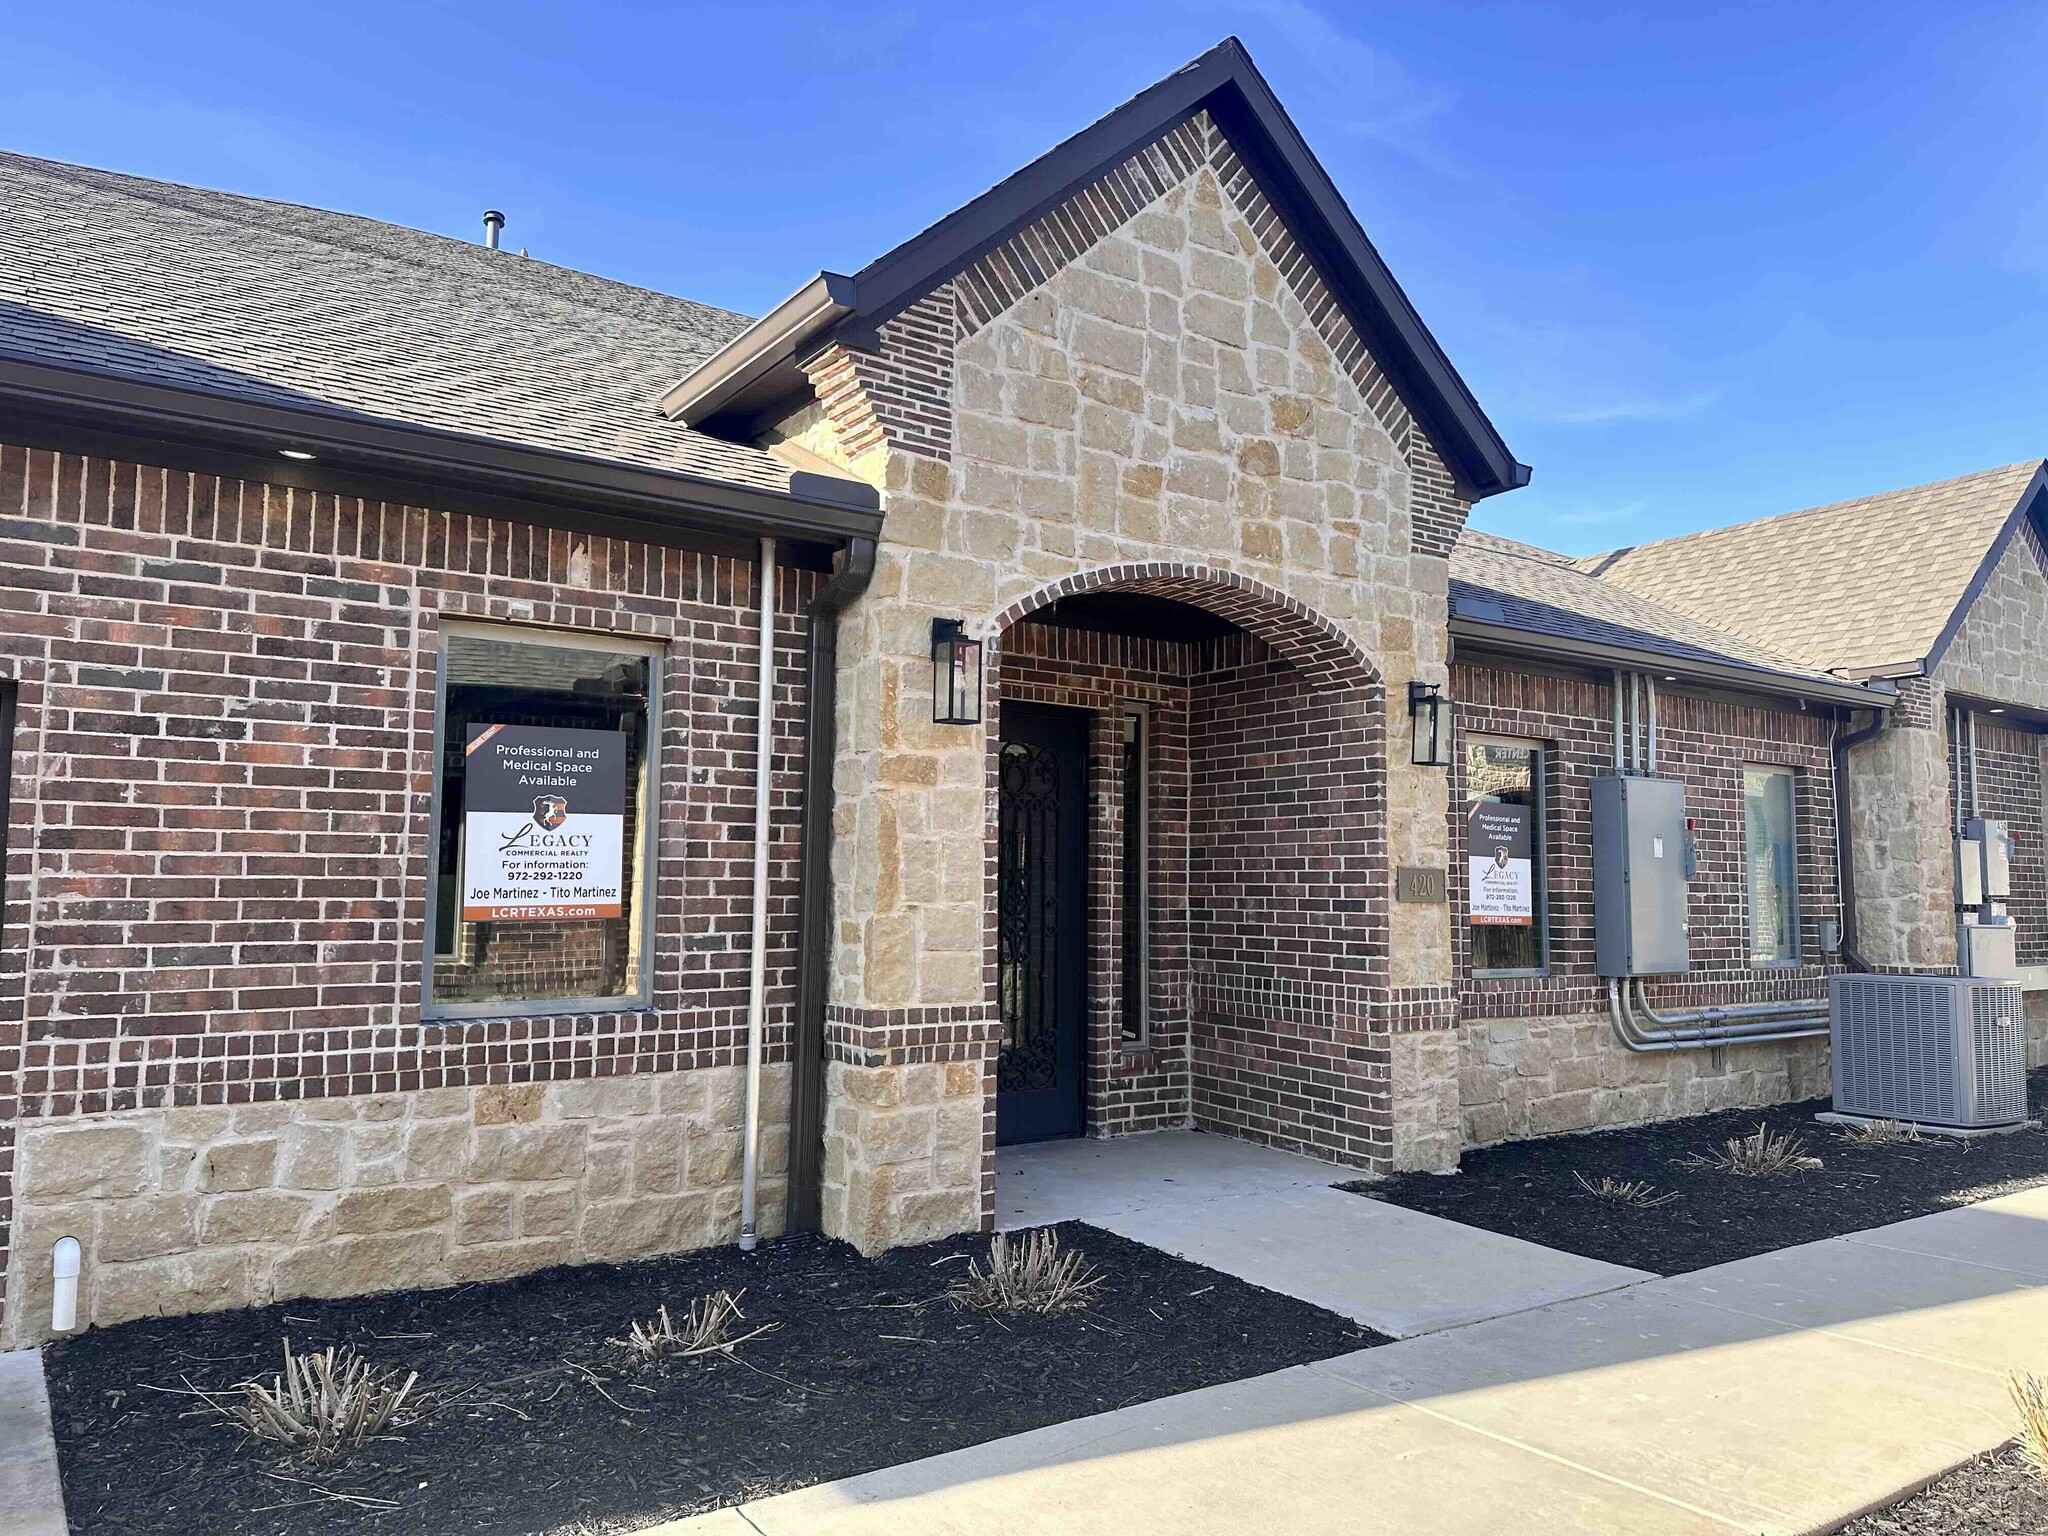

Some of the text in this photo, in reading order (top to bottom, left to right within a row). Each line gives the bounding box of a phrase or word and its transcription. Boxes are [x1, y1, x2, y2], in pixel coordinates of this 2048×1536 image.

[496, 744, 599, 759] Professional and
[503, 760, 592, 773] Medical Space
[518, 775, 577, 787] Available
[1479, 813, 1510, 823] Professional
[1482, 823, 1518, 833] Medical Space
[1488, 833, 1512, 841] Available
[502, 860, 589, 869] For information:
[507, 871, 583, 881] 972-292-1220
[1410, 873, 1435, 897] 420
[470, 888, 490, 900] Joe
[493, 887, 539, 899] Martinez
[550, 886, 571, 898] Tito
[573, 886, 617, 898] Martinez
[491, 905, 596, 918] LCRTEXAS.com
[1472, 903, 1480, 911] Joe
[1480, 903, 1500, 912] Martinez
[1480, 916, 1522, 924] LCRTEXAS.com
